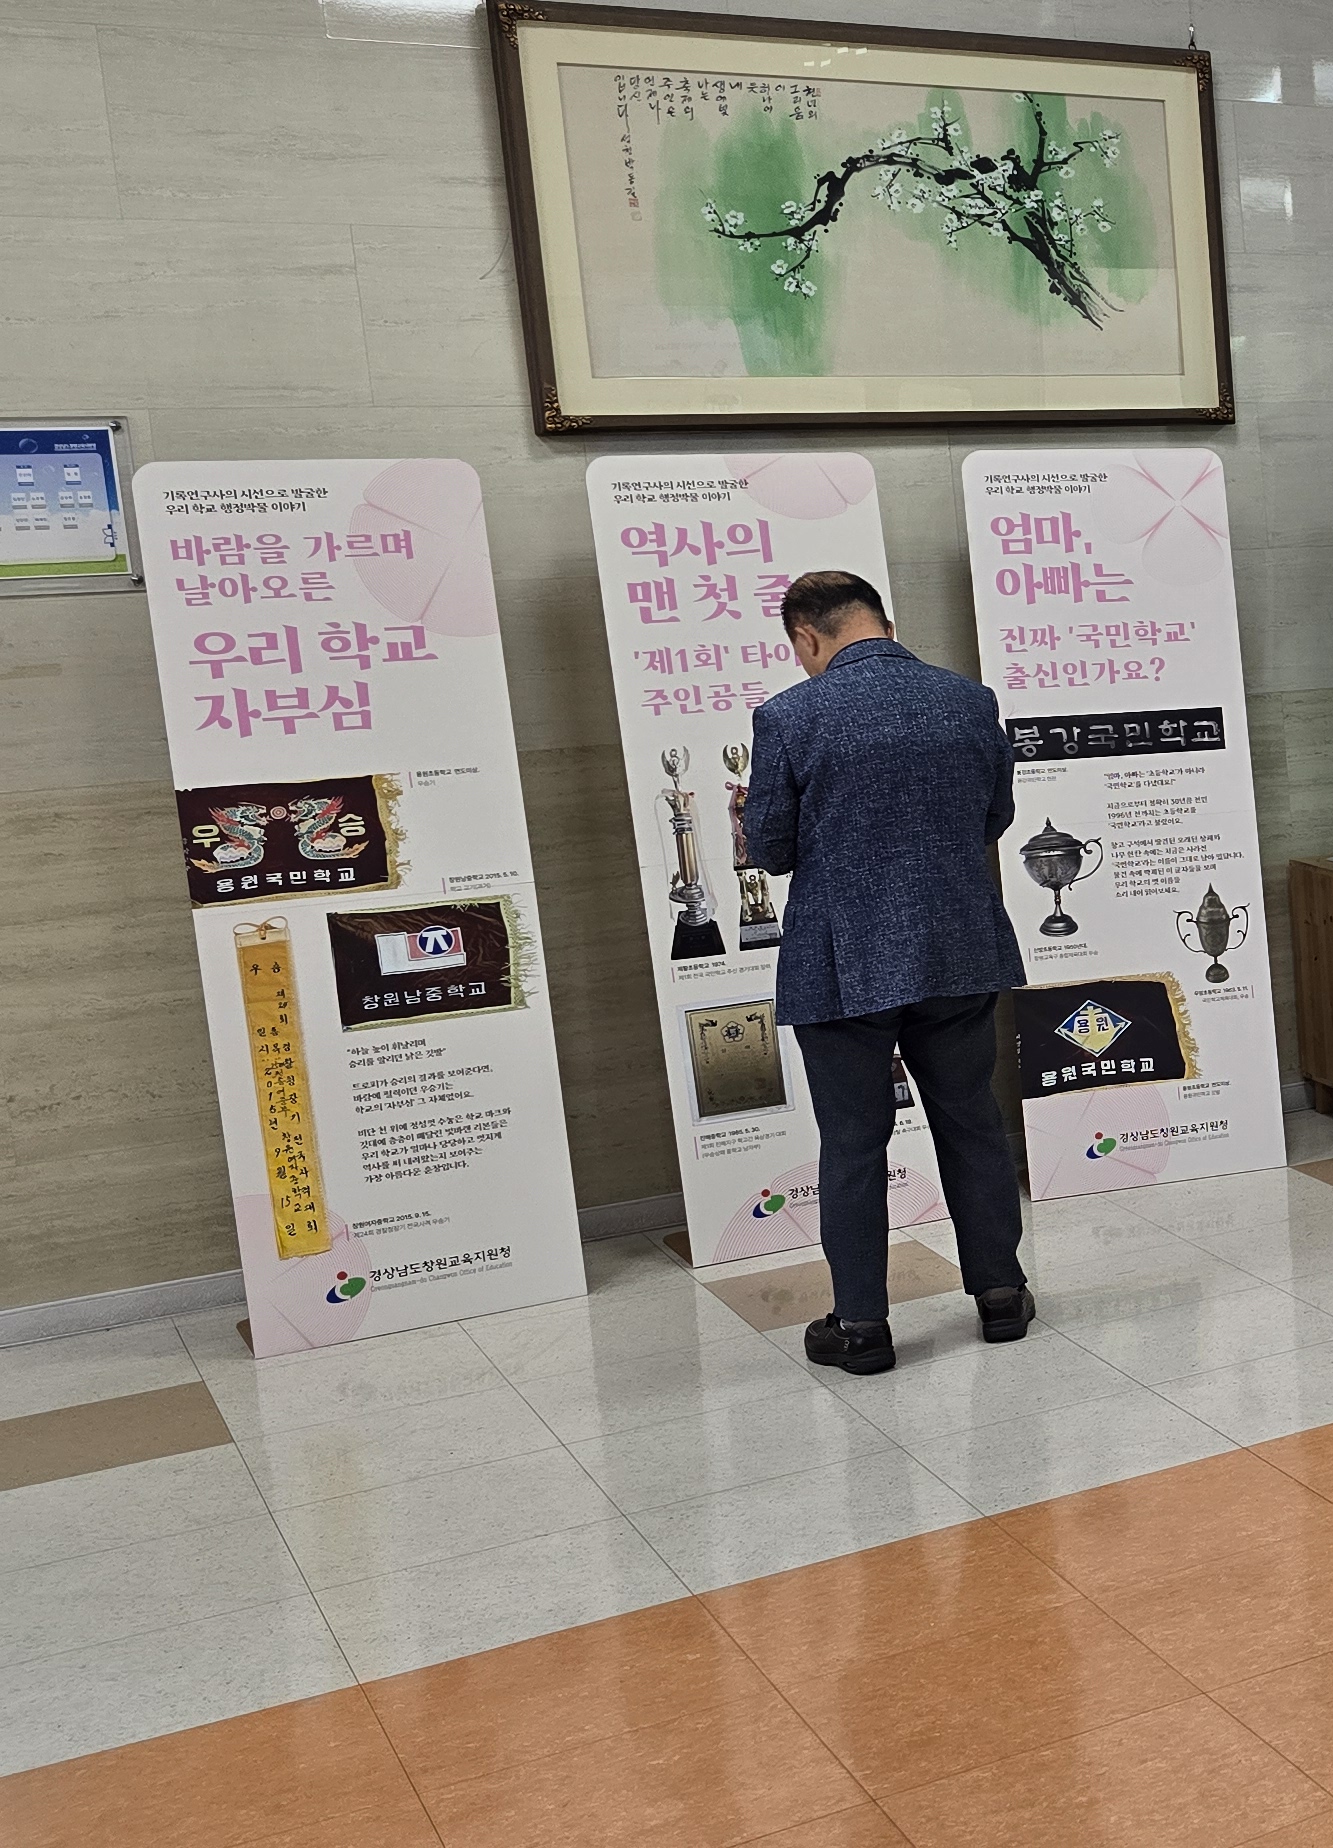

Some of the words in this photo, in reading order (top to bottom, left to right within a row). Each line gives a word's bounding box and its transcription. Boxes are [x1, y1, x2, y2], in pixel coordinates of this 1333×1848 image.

[163, 489, 238, 501] 기록연구사의
[240, 489, 289, 500] 시선으로
[291, 487, 328, 499] 발굴한
[611, 481, 674, 491] 기록연구사의
[676, 481, 717, 490] 시선으로
[718, 480, 749, 490] 발굴한
[984, 474, 1040, 484] 기록연구사의
[1042, 474, 1078, 483] 시선으로
[1080, 473, 1108, 482] 발굴한
[985, 486, 1003, 495] 우리
[1005, 486, 1024, 495] 학교
[1026, 485, 1062, 495] 행정박물
[1064, 484, 1091, 494] 이야기
[165, 504, 189, 515] 우리
[192, 503, 217, 514] 학교
[220, 502, 268, 514] 행정박물
[271, 501, 307, 512] 이야기
[613, 495, 634, 504] 우리
[635, 494, 657, 503] 학교
[659, 493, 699, 503] 행정박물
[701, 492, 731, 502] 이야기
[170, 533, 291, 567] 바람을
[302, 529, 415, 563] 가르며
[620, 518, 774, 567] 역사의
[990, 511, 1093, 555] 엄마,
[175, 571, 336, 607] 날아오른
[626, 576, 681, 625] 맨
[693, 573, 742, 622] 첫
[995, 561, 1134, 605] 아빠는
[189, 625, 301, 679] 우리
[318, 621, 439, 676] 학교
[999, 624, 1061, 653] 진짜
[1068, 620, 1196, 649] '국민학교'
[634, 643, 730, 675] '제1회'
[1003, 656, 1166, 690] 출신인가요?
[194, 681, 373, 738] 자부심
[641, 681, 770, 716] 주인공들
[1012, 719, 1221, 757] 봉강국민학교
[192, 825, 220, 848] 우
[337, 814, 367, 837] 승
[216, 868, 356, 893] 용원국민학교
[362, 982, 487, 1010] 창원남중학교
[1041, 1057, 1155, 1087] 용원국민학교
[1119, 1119, 1229, 1143] 경상남도창원교육지원청
[369, 1246, 511, 1281] 경상남도창원교육지원청
